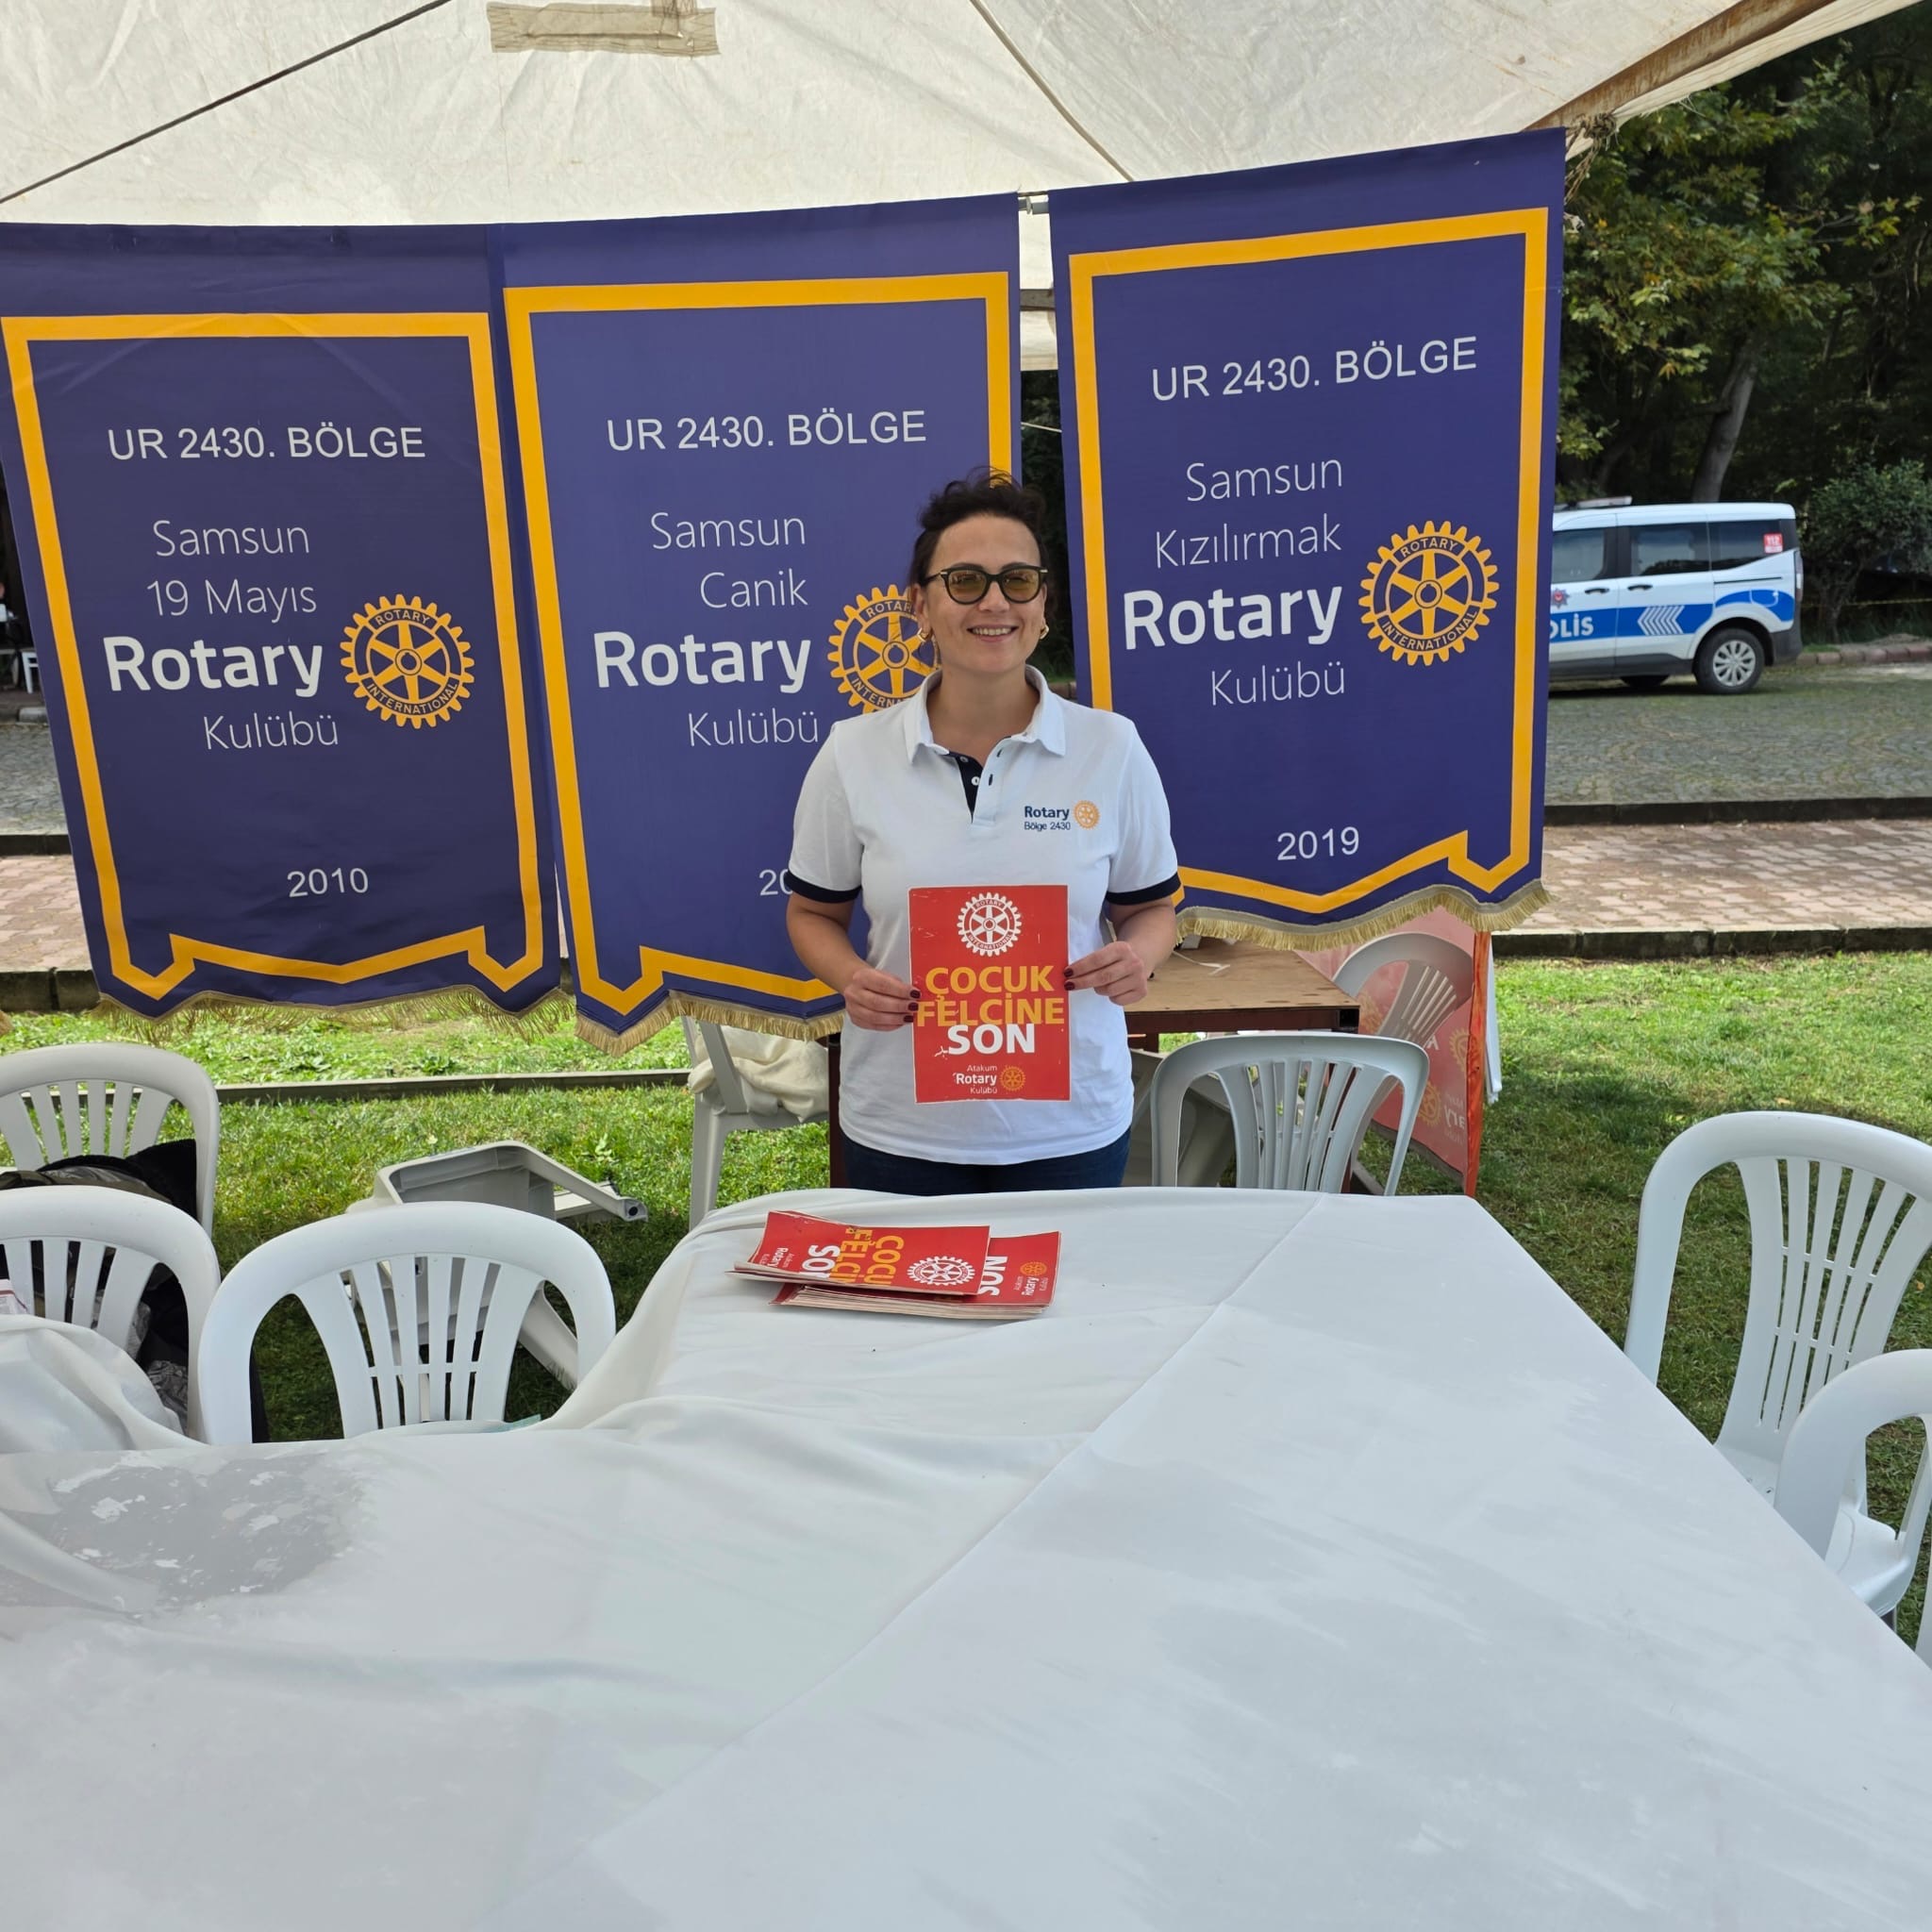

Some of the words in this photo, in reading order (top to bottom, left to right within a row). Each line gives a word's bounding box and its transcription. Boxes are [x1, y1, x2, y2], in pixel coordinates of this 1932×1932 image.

[1153, 365, 1209, 400] UR
[1223, 356, 1319, 394] 2430.
[1337, 337, 1475, 383] BÖLGE
[108, 429, 167, 459] UR
[178, 427, 275, 458] 2430.
[288, 422, 425, 458] BÖLGE
[608, 419, 665, 450] UR
[677, 416, 773, 448] 2430.
[789, 408, 925, 445] BÖLGE
[1187, 460, 1341, 501] Samsun
[154, 521, 308, 556] Samsun
[652, 512, 805, 549] Samsun
[1157, 513, 1341, 568] Kızılırmak
[1400, 537, 1457, 558] ROTARY
[147, 580, 188, 615] 19
[206, 579, 316, 623] Mayıs
[701, 569, 808, 608] Canik
[375, 609, 430, 625] ROTARY
[865, 601, 912, 617] ROTAR
[1124, 587, 1341, 649] Rotary
[1382, 610, 1477, 651] INTERNATIONAL
[104, 637, 322, 697] Rotary
[594, 632, 810, 693] Rotary
[366, 683, 458, 714] INTERNATIONAL
[1212, 661, 1343, 705] Kulübü
[204, 711, 338, 749] Kulübü
[689, 708, 820, 748] Kulübü
[1024, 805, 1070, 821] Rotary
[1049, 822, 1071, 830] 2430
[1278, 827, 1358, 860] 2019
[288, 868, 368, 897] 2010
[758, 869, 793, 896] 20
[947, 1023, 1036, 1055] SON
[955, 1073, 997, 1086] Rotary
[966, 1063, 998, 1073] Atakum
